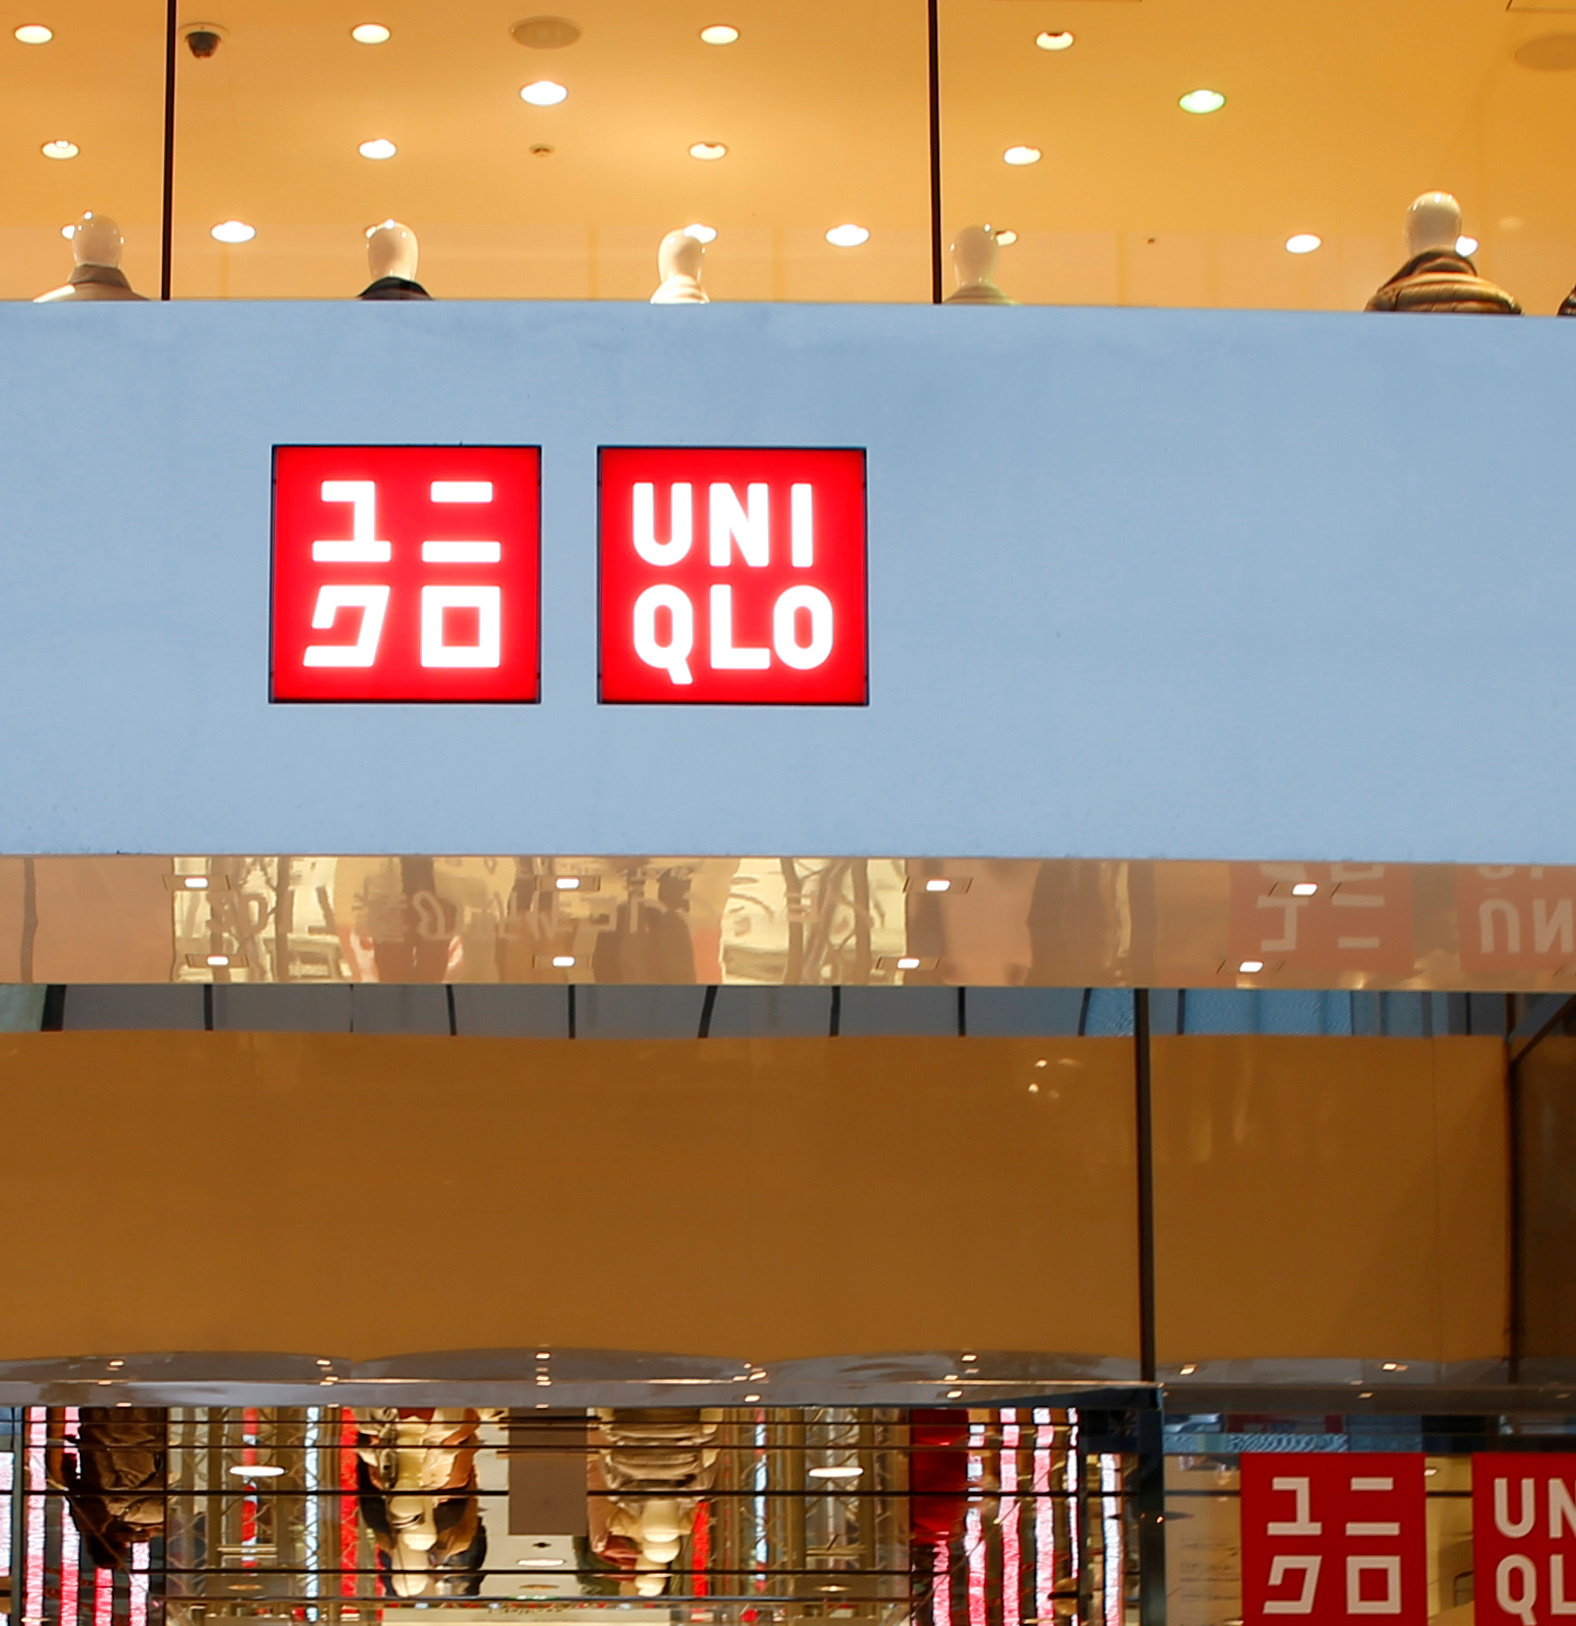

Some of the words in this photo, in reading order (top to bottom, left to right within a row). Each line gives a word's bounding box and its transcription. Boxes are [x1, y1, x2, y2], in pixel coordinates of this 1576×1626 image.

[312, 480, 501, 563] ユニ
[632, 481, 814, 568] UNI
[303, 584, 501, 668] クロ
[633, 584, 834, 685] QLO
[1266, 1476, 1401, 1536] ユニ
[1262, 1554, 1402, 1615] クロ
